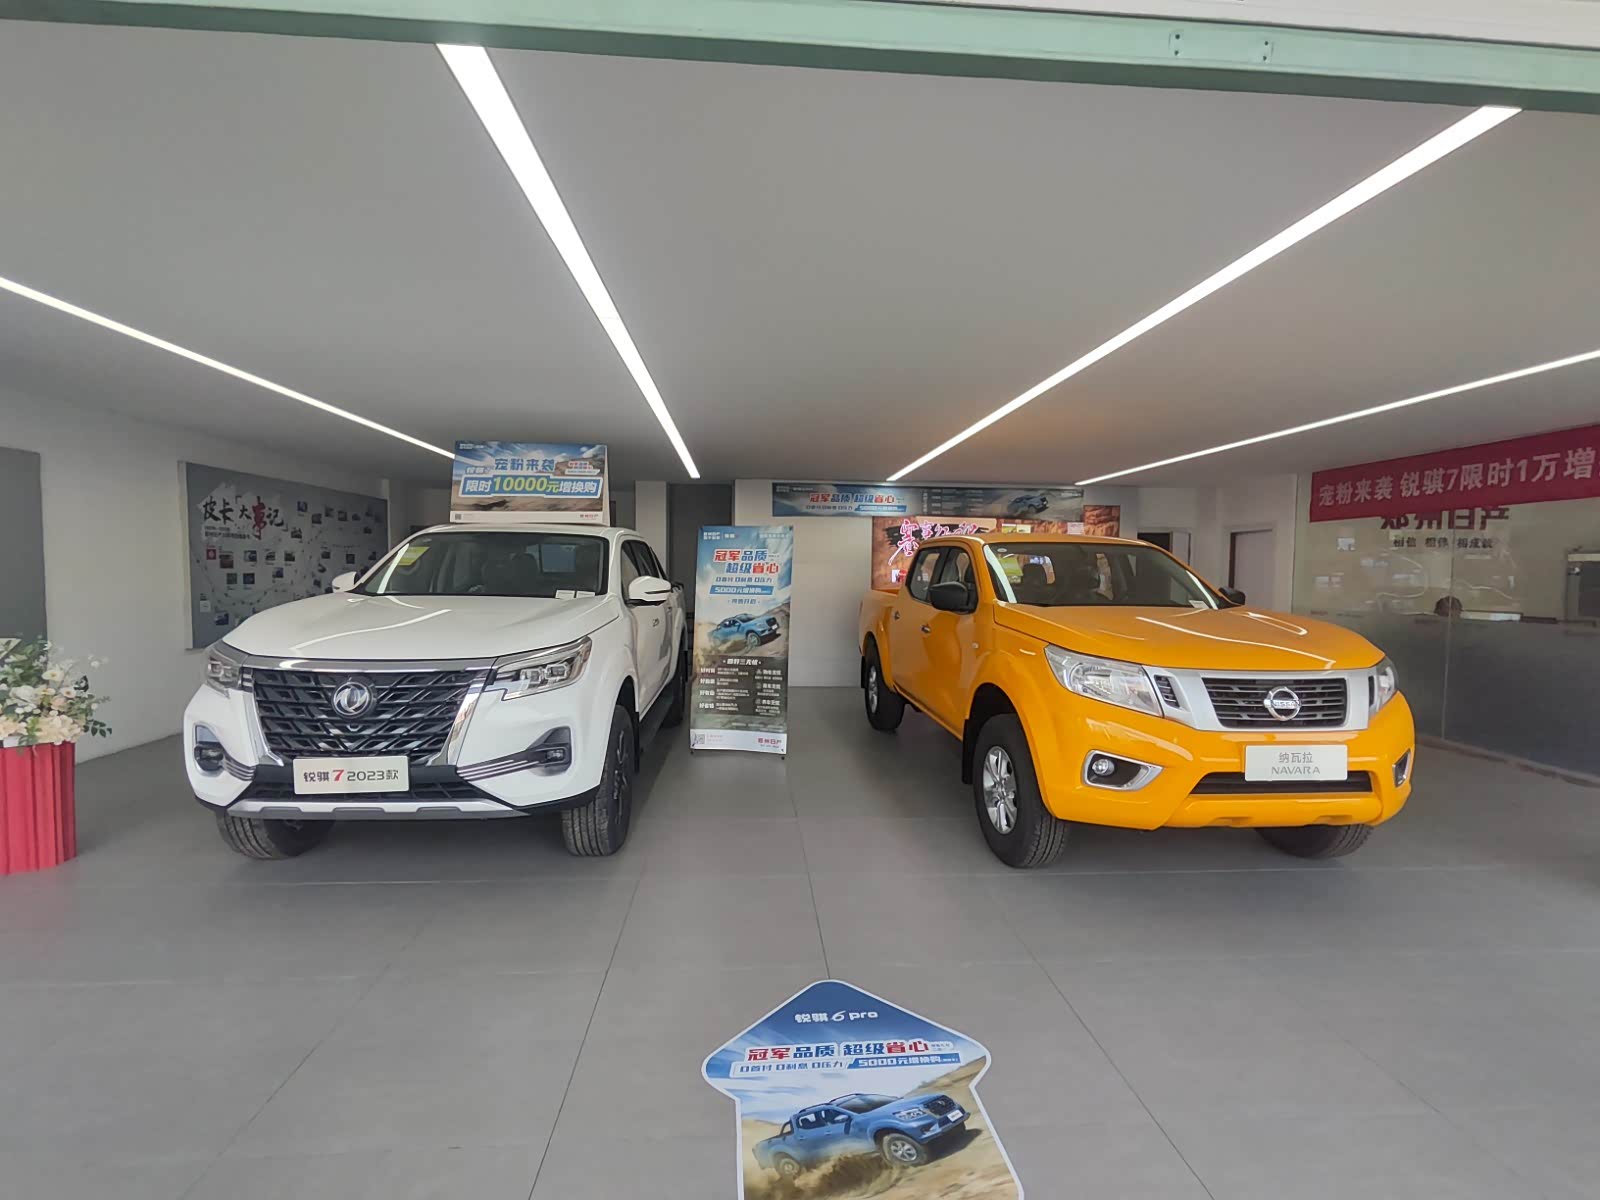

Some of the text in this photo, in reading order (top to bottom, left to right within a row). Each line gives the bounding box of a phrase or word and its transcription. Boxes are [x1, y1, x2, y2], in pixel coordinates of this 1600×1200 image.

[465, 477, 597, 494] 限时10000元增换购
[1318, 476, 1394, 506] 宠粉来袭
[714, 550, 768, 561] 冠军品质
[726, 562, 779, 574] 超级省心
[1279, 752, 1313, 764] 纳瓦拉
[303, 769, 399, 782] 锐骐7 2023款
[1271, 766, 1321, 775] NAVARA
[848, 1011, 879, 1021] pro
[747, 1044, 835, 1061] 冠军品质
[843, 1040, 929, 1056] 超级省心
[858, 1055, 941, 1067] 5000元增换购
